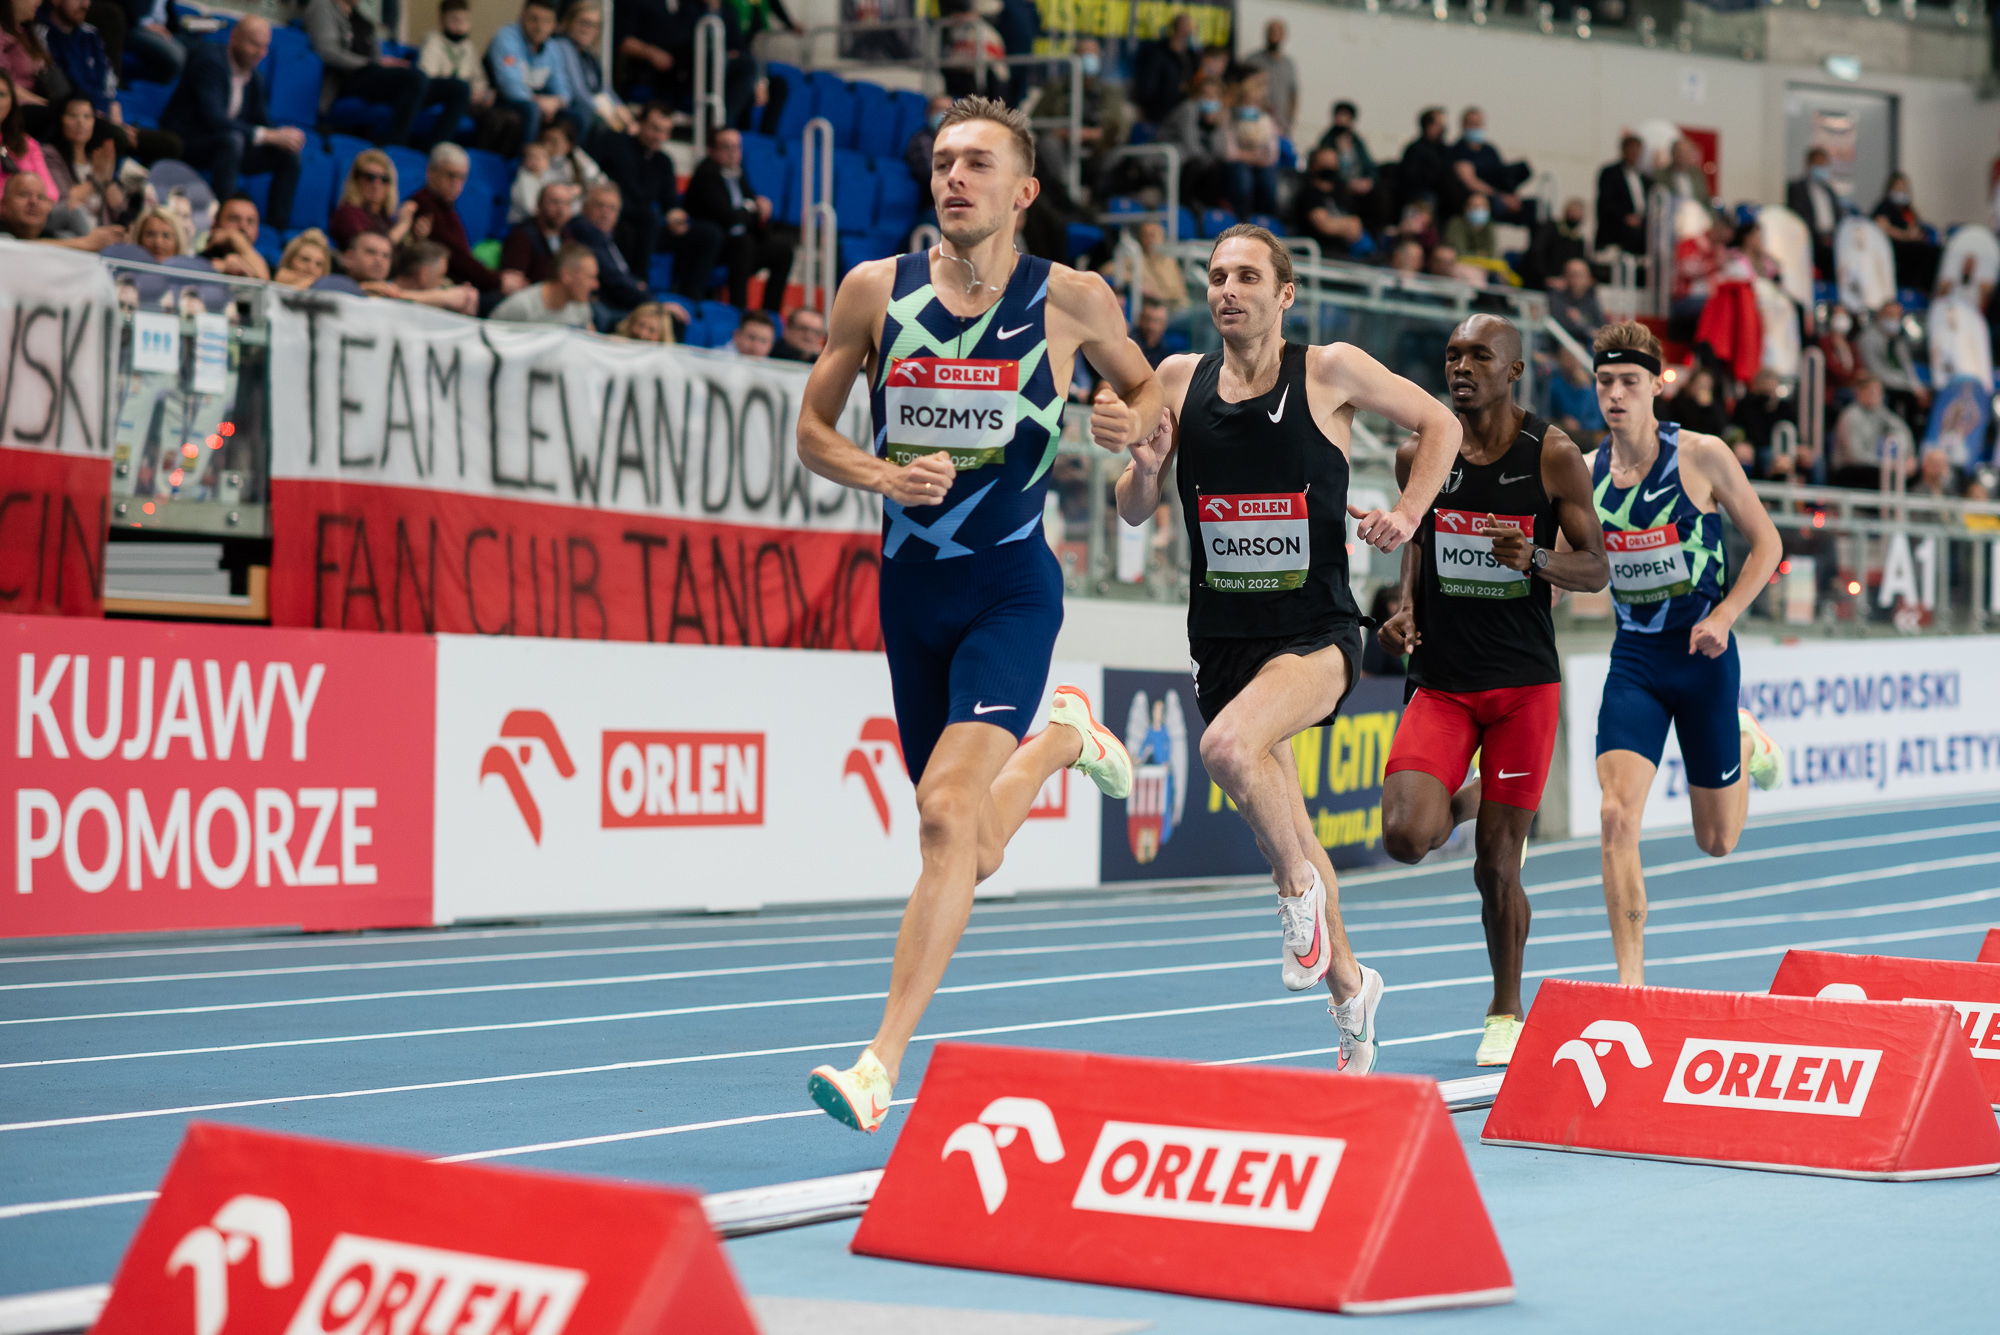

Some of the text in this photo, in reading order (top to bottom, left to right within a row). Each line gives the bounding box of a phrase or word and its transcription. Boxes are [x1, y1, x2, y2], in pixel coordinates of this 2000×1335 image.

[1, 302, 116, 450] SKI
[281, 298, 465, 477] TEAM
[938, 367, 996, 384] ORLEN
[900, 404, 1004, 430] ROZMYS
[895, 451, 937, 464] TOR
[950, 455, 977, 467] 022
[1241, 501, 1288, 514] ORLEN
[1212, 536, 1301, 556] CARSON
[1442, 547, 1500, 568] MOTS
[1628, 533, 1663, 546] ORLEN
[312, 513, 437, 636] FAN
[1213, 577, 1280, 589] TORUŃ 2022
[1477, 586, 1505, 597] 2022
[1614, 556, 1676, 579] FOPPEN
[1877, 531, 1937, 612] A1
[16, 653, 326, 761] KUJAWY
[1327, 710, 1398, 795] CITY
[1790, 742, 1888, 790] LEKKIEJ
[606, 741, 759, 818] ORLEN
[16, 787, 378, 894] POMORZE
[1683, 1049, 1863, 1105] ORLEN
[1099, 1139, 1319, 1212] ORLEN
[320, 1262, 550, 1335] ORLEN
